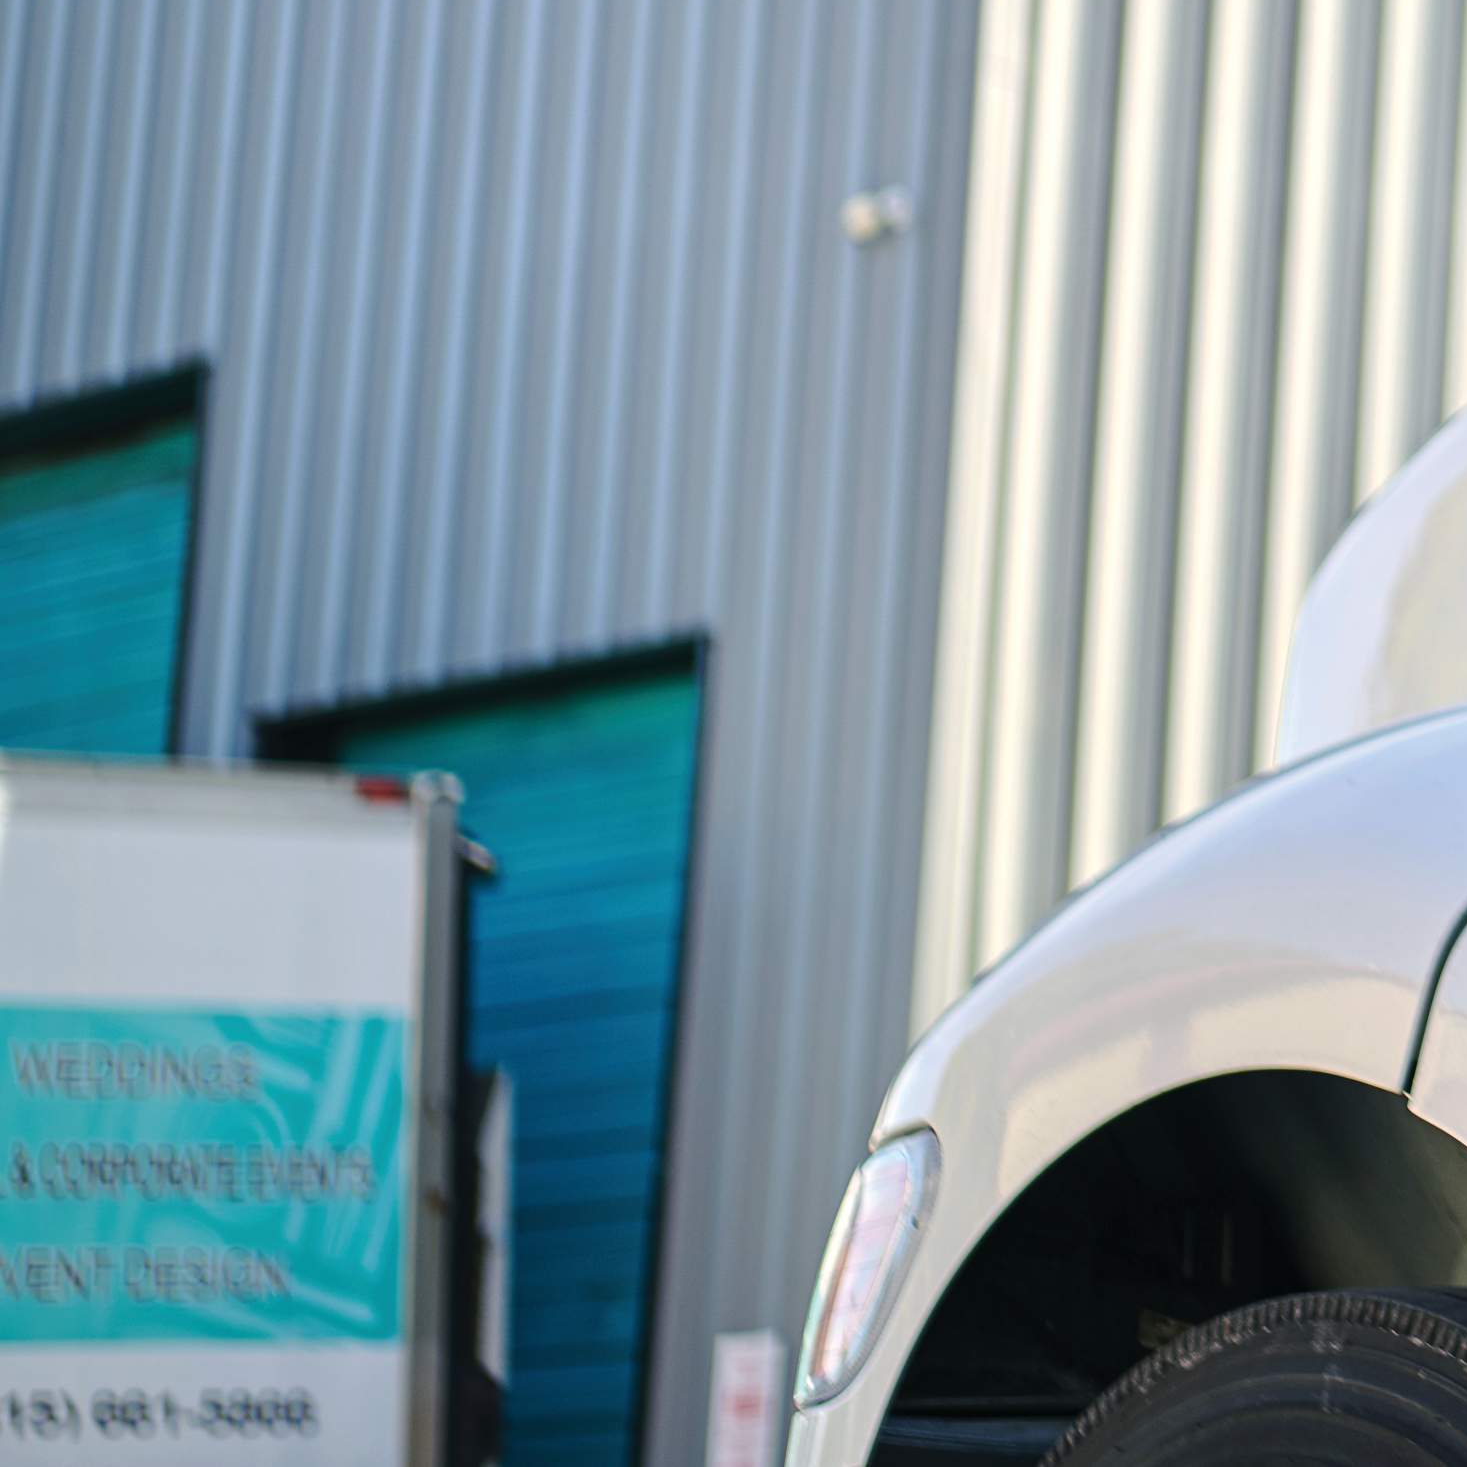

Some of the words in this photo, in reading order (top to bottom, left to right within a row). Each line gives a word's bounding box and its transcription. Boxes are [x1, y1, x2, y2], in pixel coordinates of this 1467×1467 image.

[12, 1040, 260, 1101] WEDDINGS
[37, 1141, 239, 1204] CORPORATE
[244, 1142, 378, 1206] EVENTS
[121, 1245, 294, 1305] DESIGN
